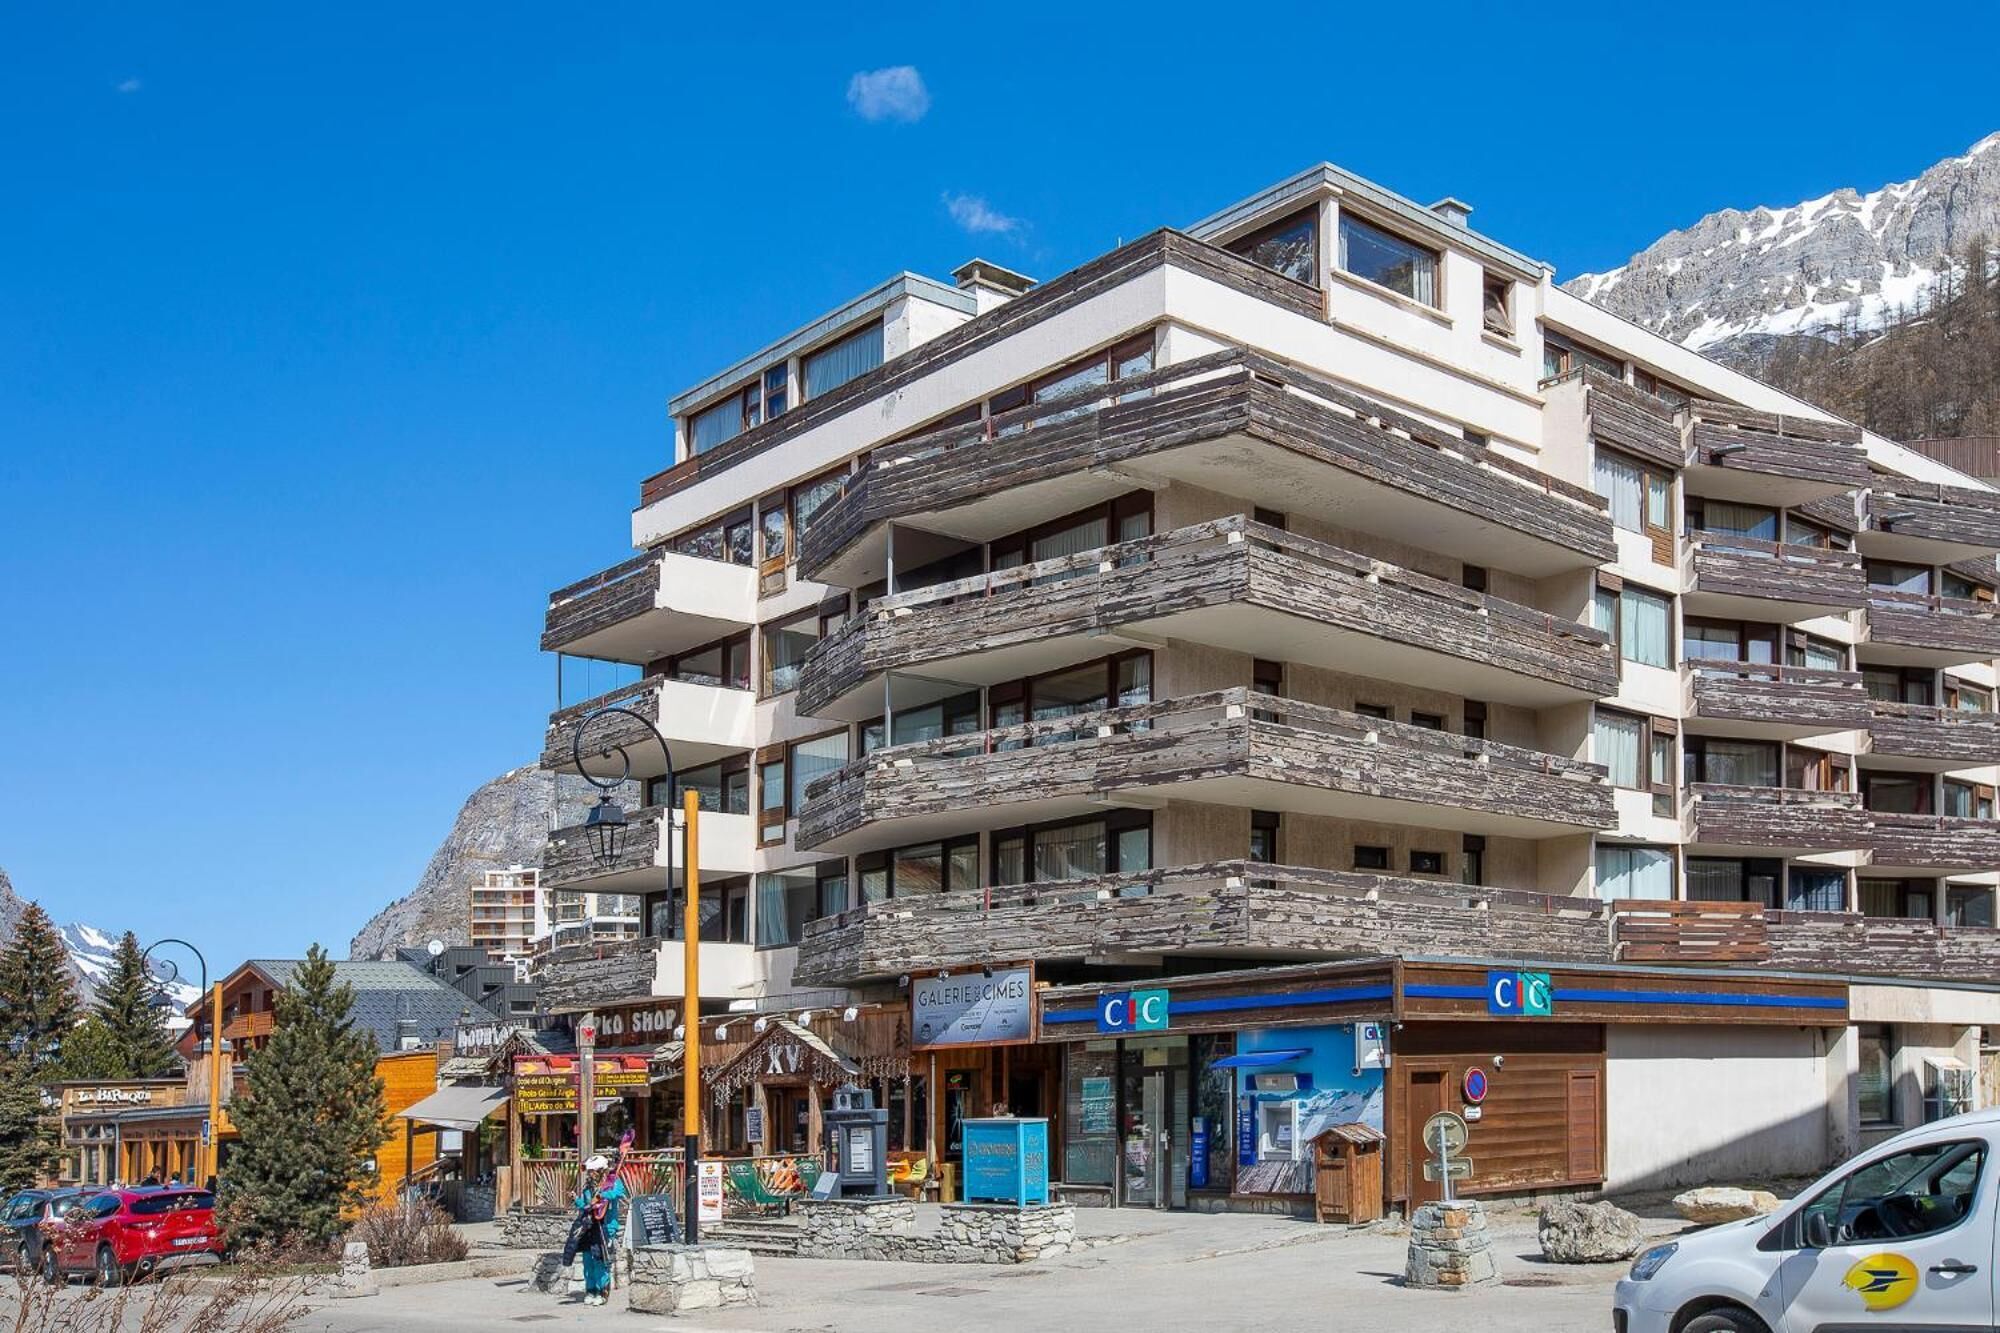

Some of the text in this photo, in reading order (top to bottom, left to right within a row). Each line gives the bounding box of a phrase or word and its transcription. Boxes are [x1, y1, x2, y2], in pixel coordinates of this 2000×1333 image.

[918, 985, 971, 1007] GALERIE
[982, 981, 1024, 1001] CIMES
[1495, 978, 1545, 1009] CIC
[632, 1009, 676, 1032] SHOP
[1104, 996, 1161, 1026] CIC
[518, 1089, 537, 1098] Photo
